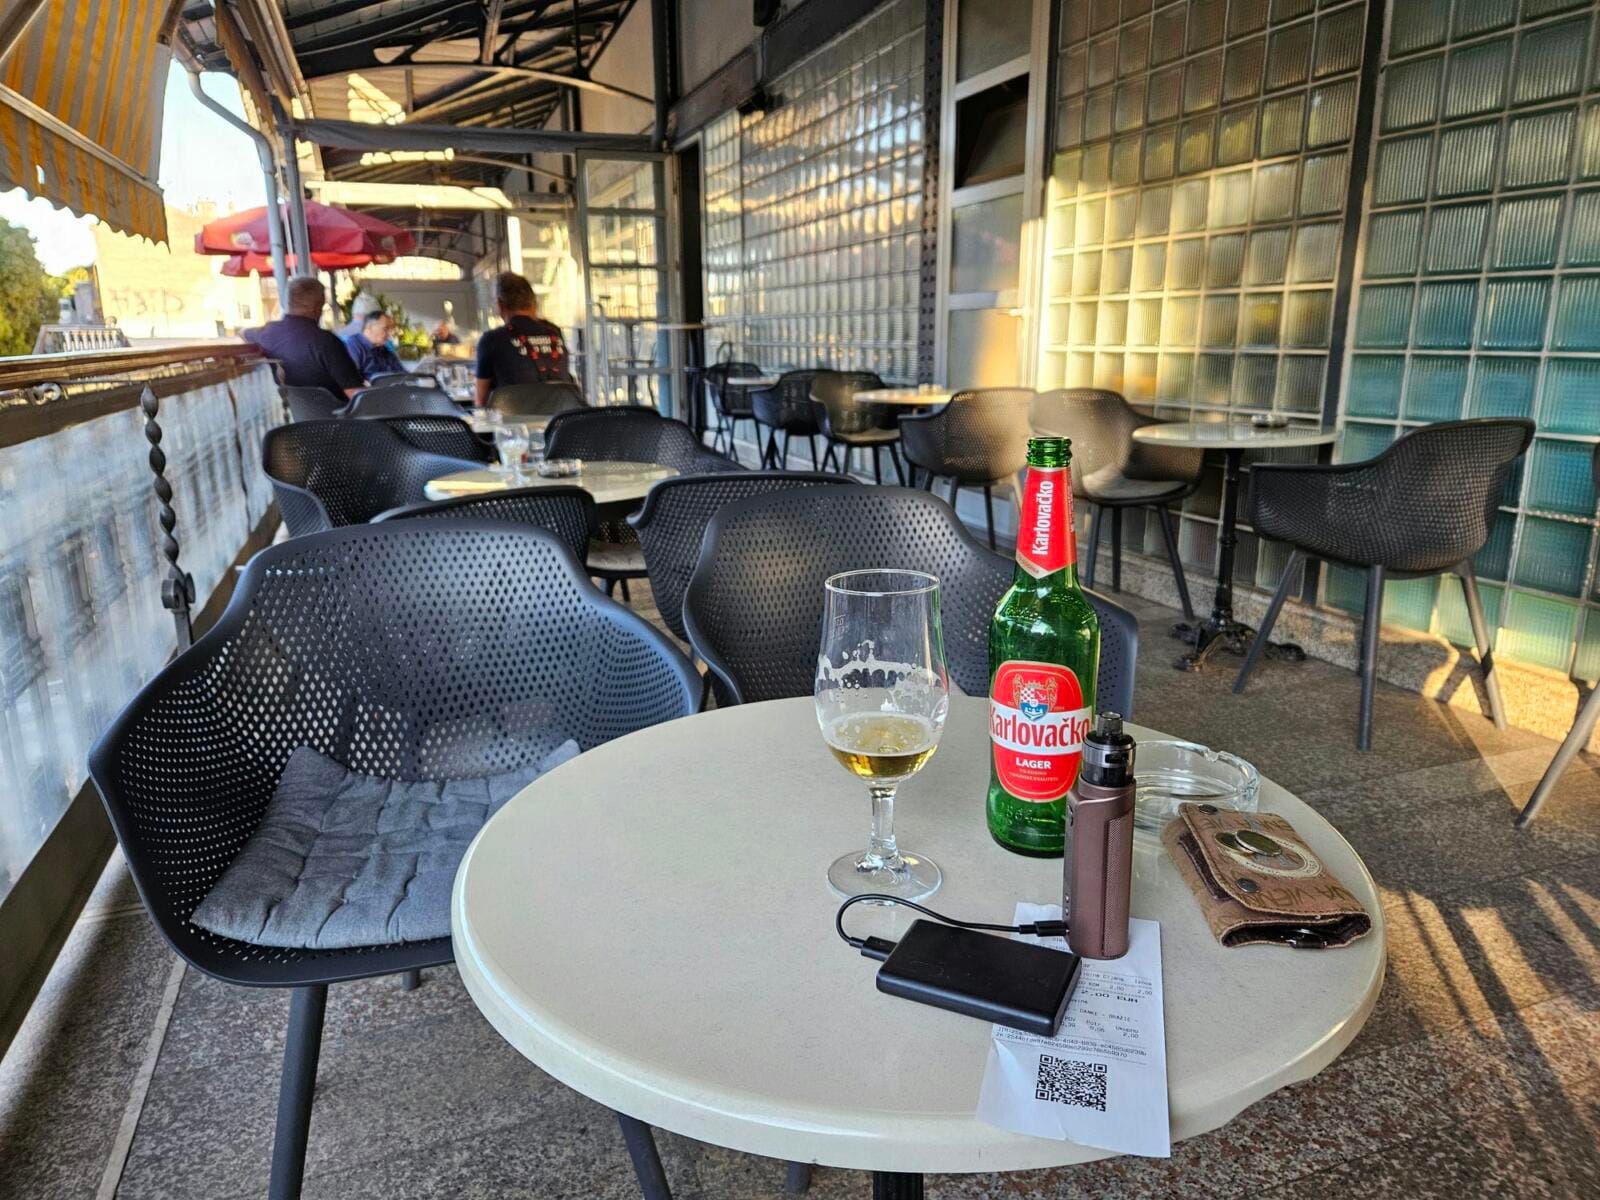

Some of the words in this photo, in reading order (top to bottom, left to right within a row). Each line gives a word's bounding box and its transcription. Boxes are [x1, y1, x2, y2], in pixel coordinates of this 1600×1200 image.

[1032, 480, 1054, 556] Karlovačko
[989, 704, 1090, 747] Karlovačko
[1015, 757, 1052, 769] LAGER
